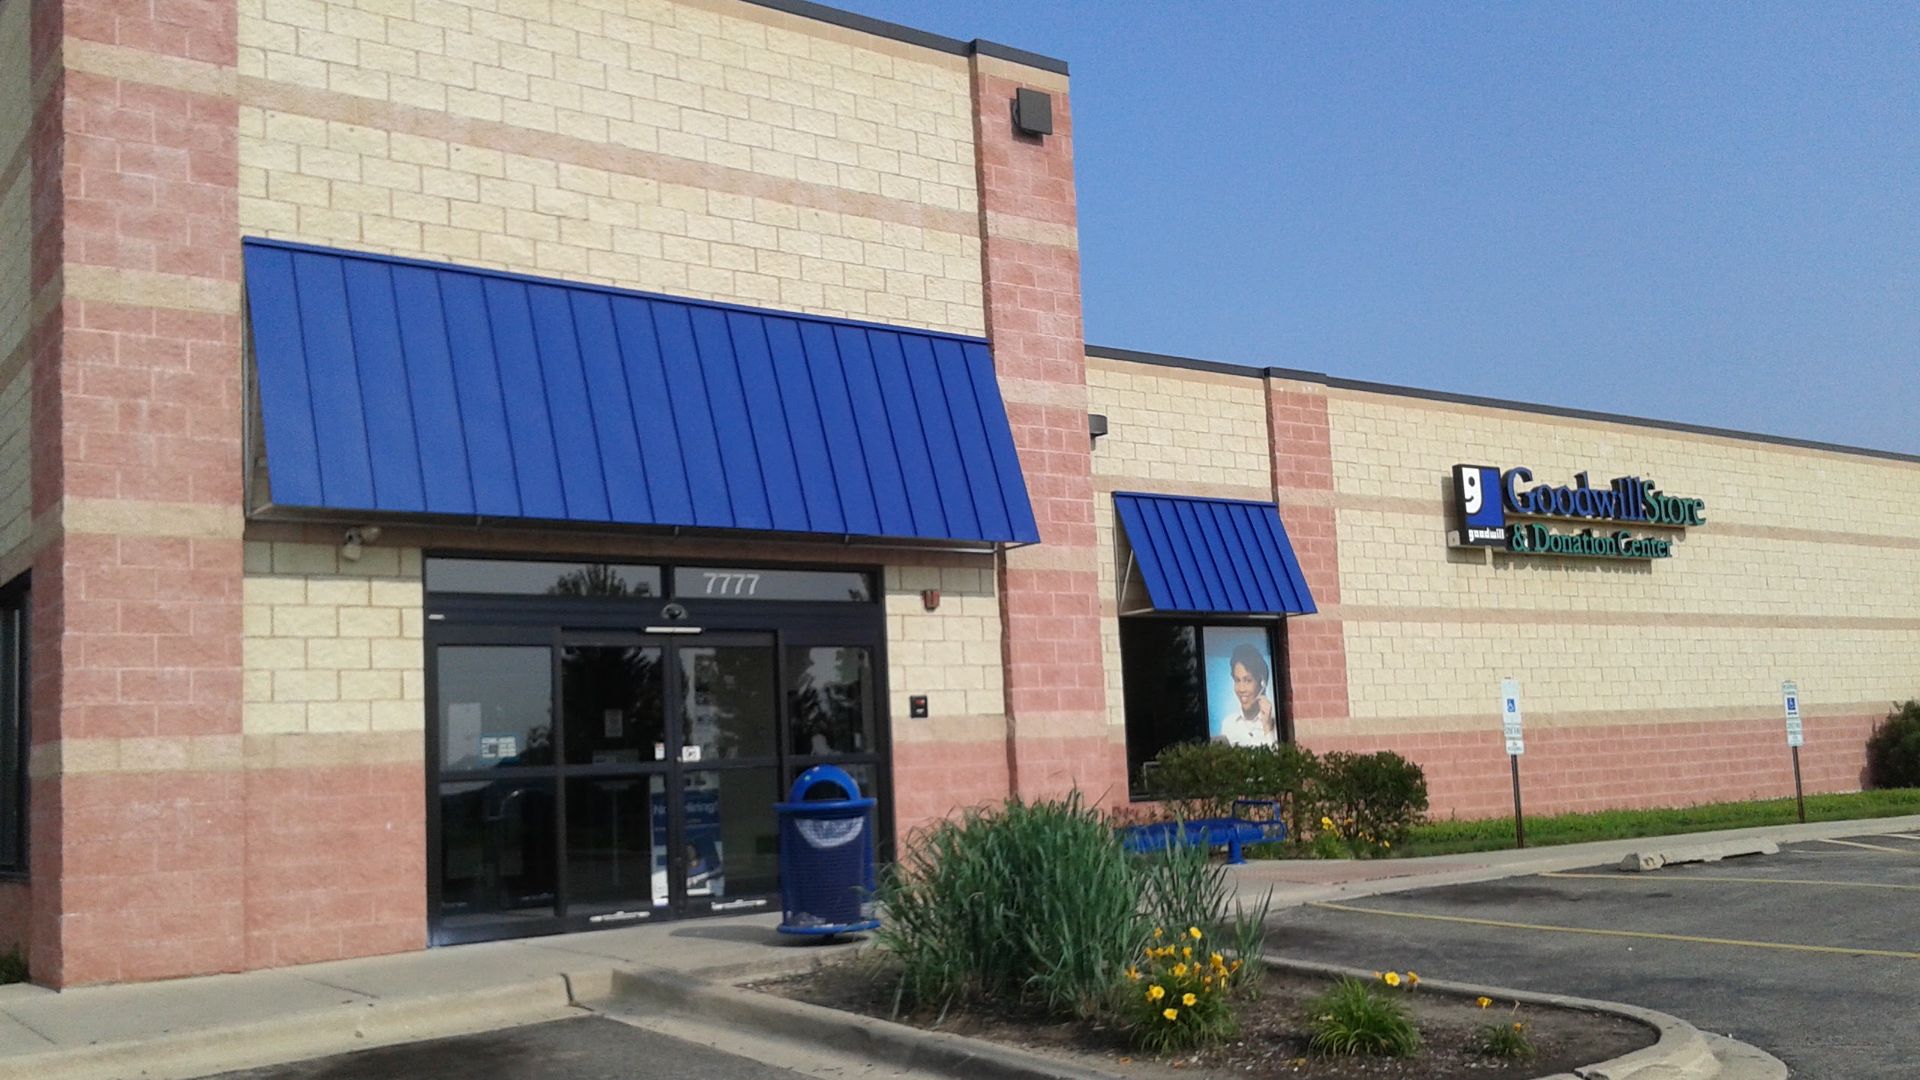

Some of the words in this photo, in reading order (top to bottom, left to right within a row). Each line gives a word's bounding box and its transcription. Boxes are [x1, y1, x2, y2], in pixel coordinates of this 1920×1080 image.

[1503, 466, 1646, 521] Goodwill
[1643, 479, 1707, 526] Store
[1468, 527, 1505, 542] goodwill
[1511, 522, 1530, 552] &
[1532, 523, 1616, 556] Donation
[1616, 530, 1673, 558] Center
[703, 572, 760, 595] 7777
